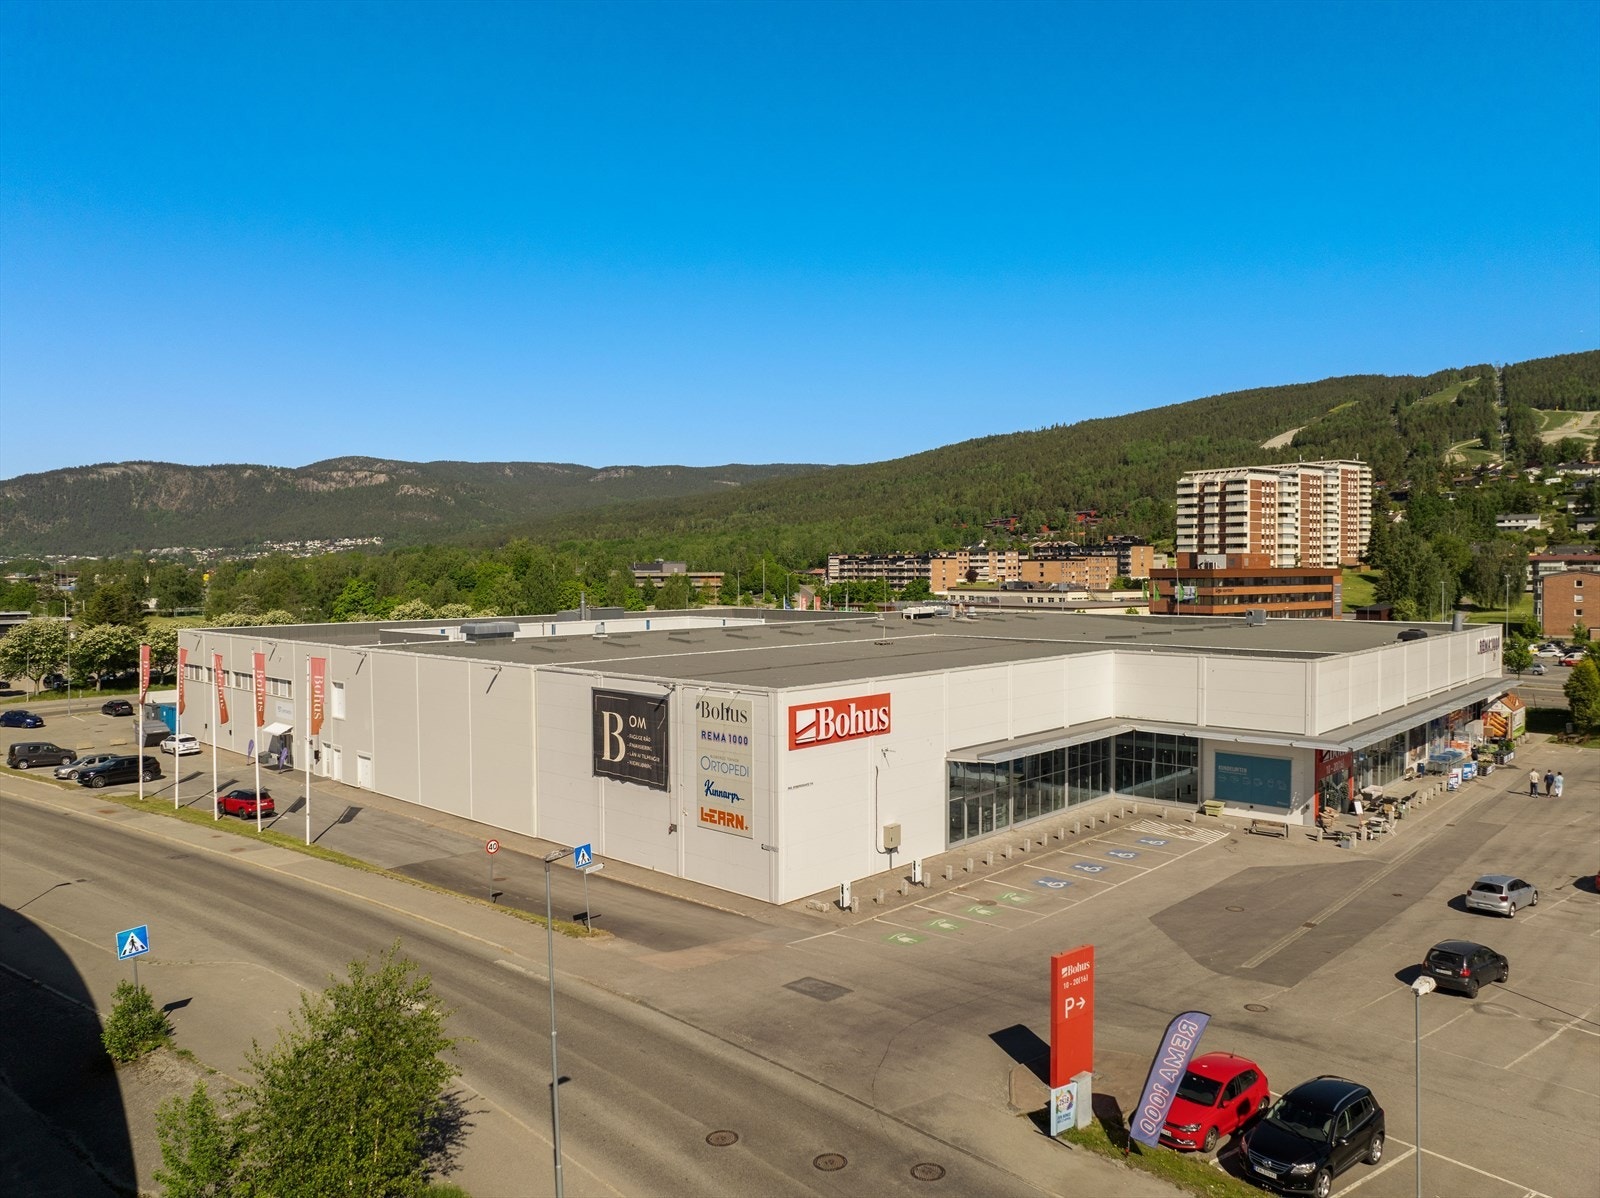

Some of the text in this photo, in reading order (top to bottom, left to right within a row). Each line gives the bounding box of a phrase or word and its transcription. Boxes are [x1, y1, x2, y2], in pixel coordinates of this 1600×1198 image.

[256, 670, 264, 712] Bohus
[314, 675, 324, 720] Bohus
[629, 715, 646, 730] OM
[700, 700, 748, 724] Bohus
[816, 703, 890, 740] Bohus
[601, 710, 626, 762] B
[701, 730, 749, 746] REMA 1000
[704, 779, 744, 804] Kinnarps
[701, 806, 744, 830] LEARN
[488, 842, 497, 850] 40
[1068, 961, 1090, 976] Bohus
[1073, 975, 1089, 987] 20(16)
[1065, 997, 1074, 1018] P
